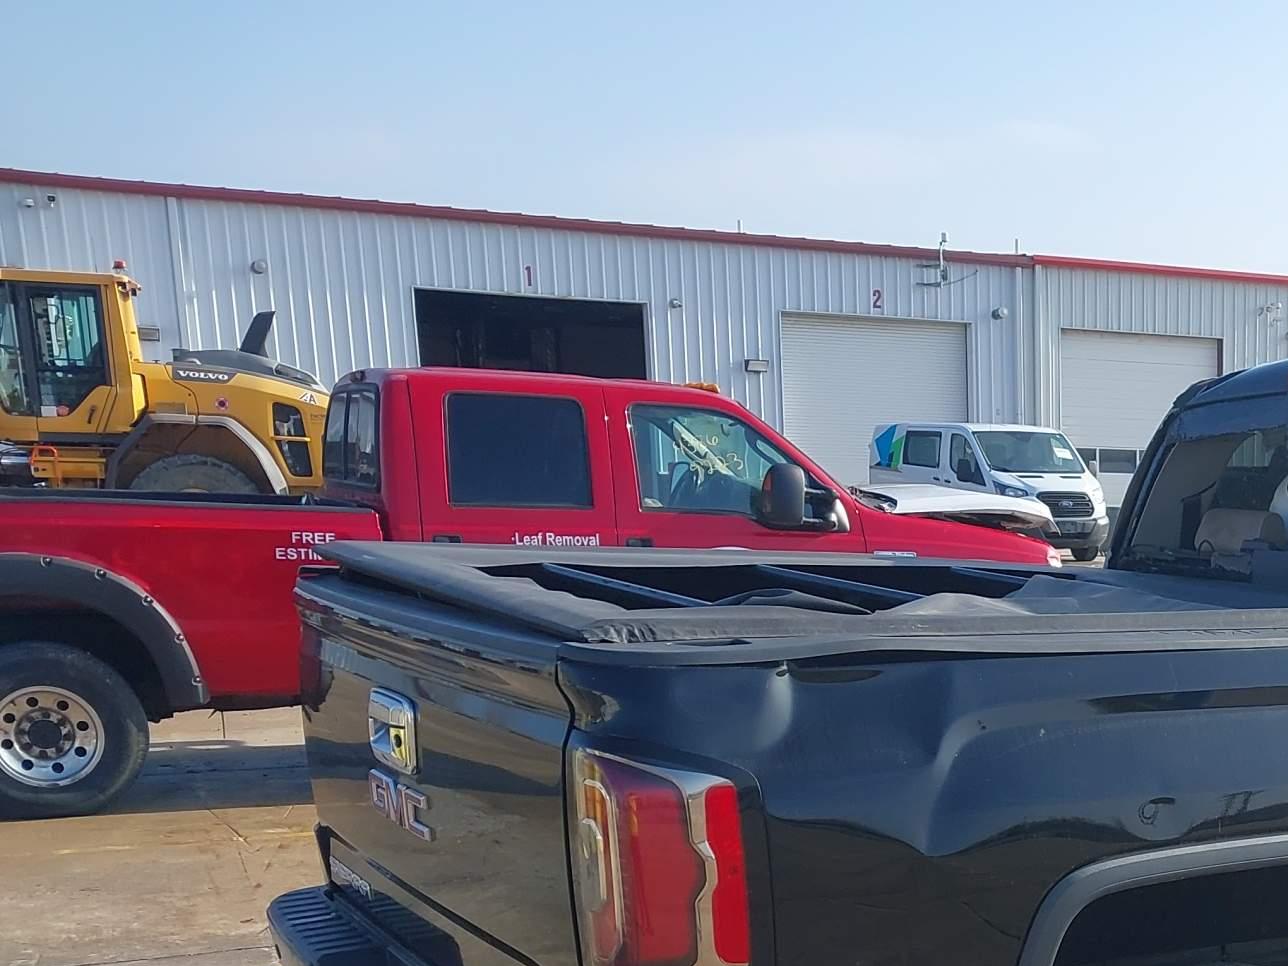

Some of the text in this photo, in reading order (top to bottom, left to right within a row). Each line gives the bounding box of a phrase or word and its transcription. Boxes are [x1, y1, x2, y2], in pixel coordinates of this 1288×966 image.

[525, 265, 532, 286] 1
[872, 289, 882, 309] 2
[177, 369, 229, 381] VOLVO
[291, 531, 336, 545] FREE
[545, 532, 600, 546] Removal
[368, 768, 432, 842] GMC
